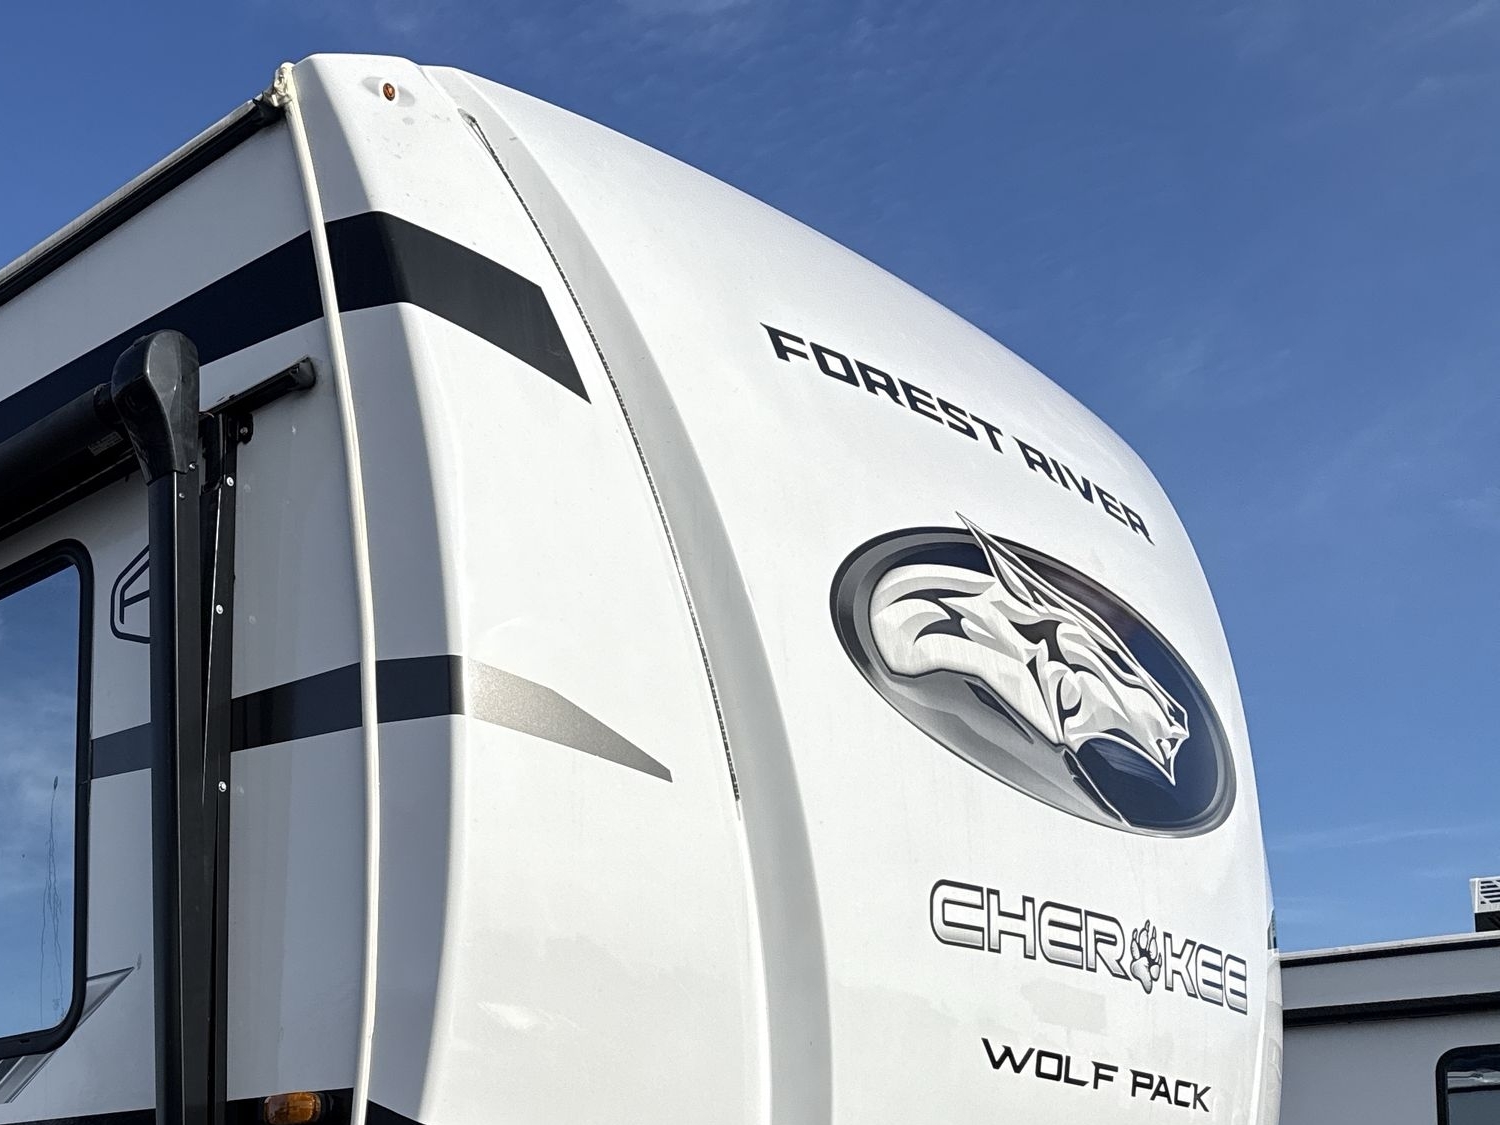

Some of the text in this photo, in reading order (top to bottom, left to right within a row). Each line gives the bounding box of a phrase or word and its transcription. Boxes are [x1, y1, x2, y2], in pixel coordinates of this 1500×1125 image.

[759, 322, 1156, 545] FOREST RIVER
[981, 1037, 1212, 1113] WOLF PACK
